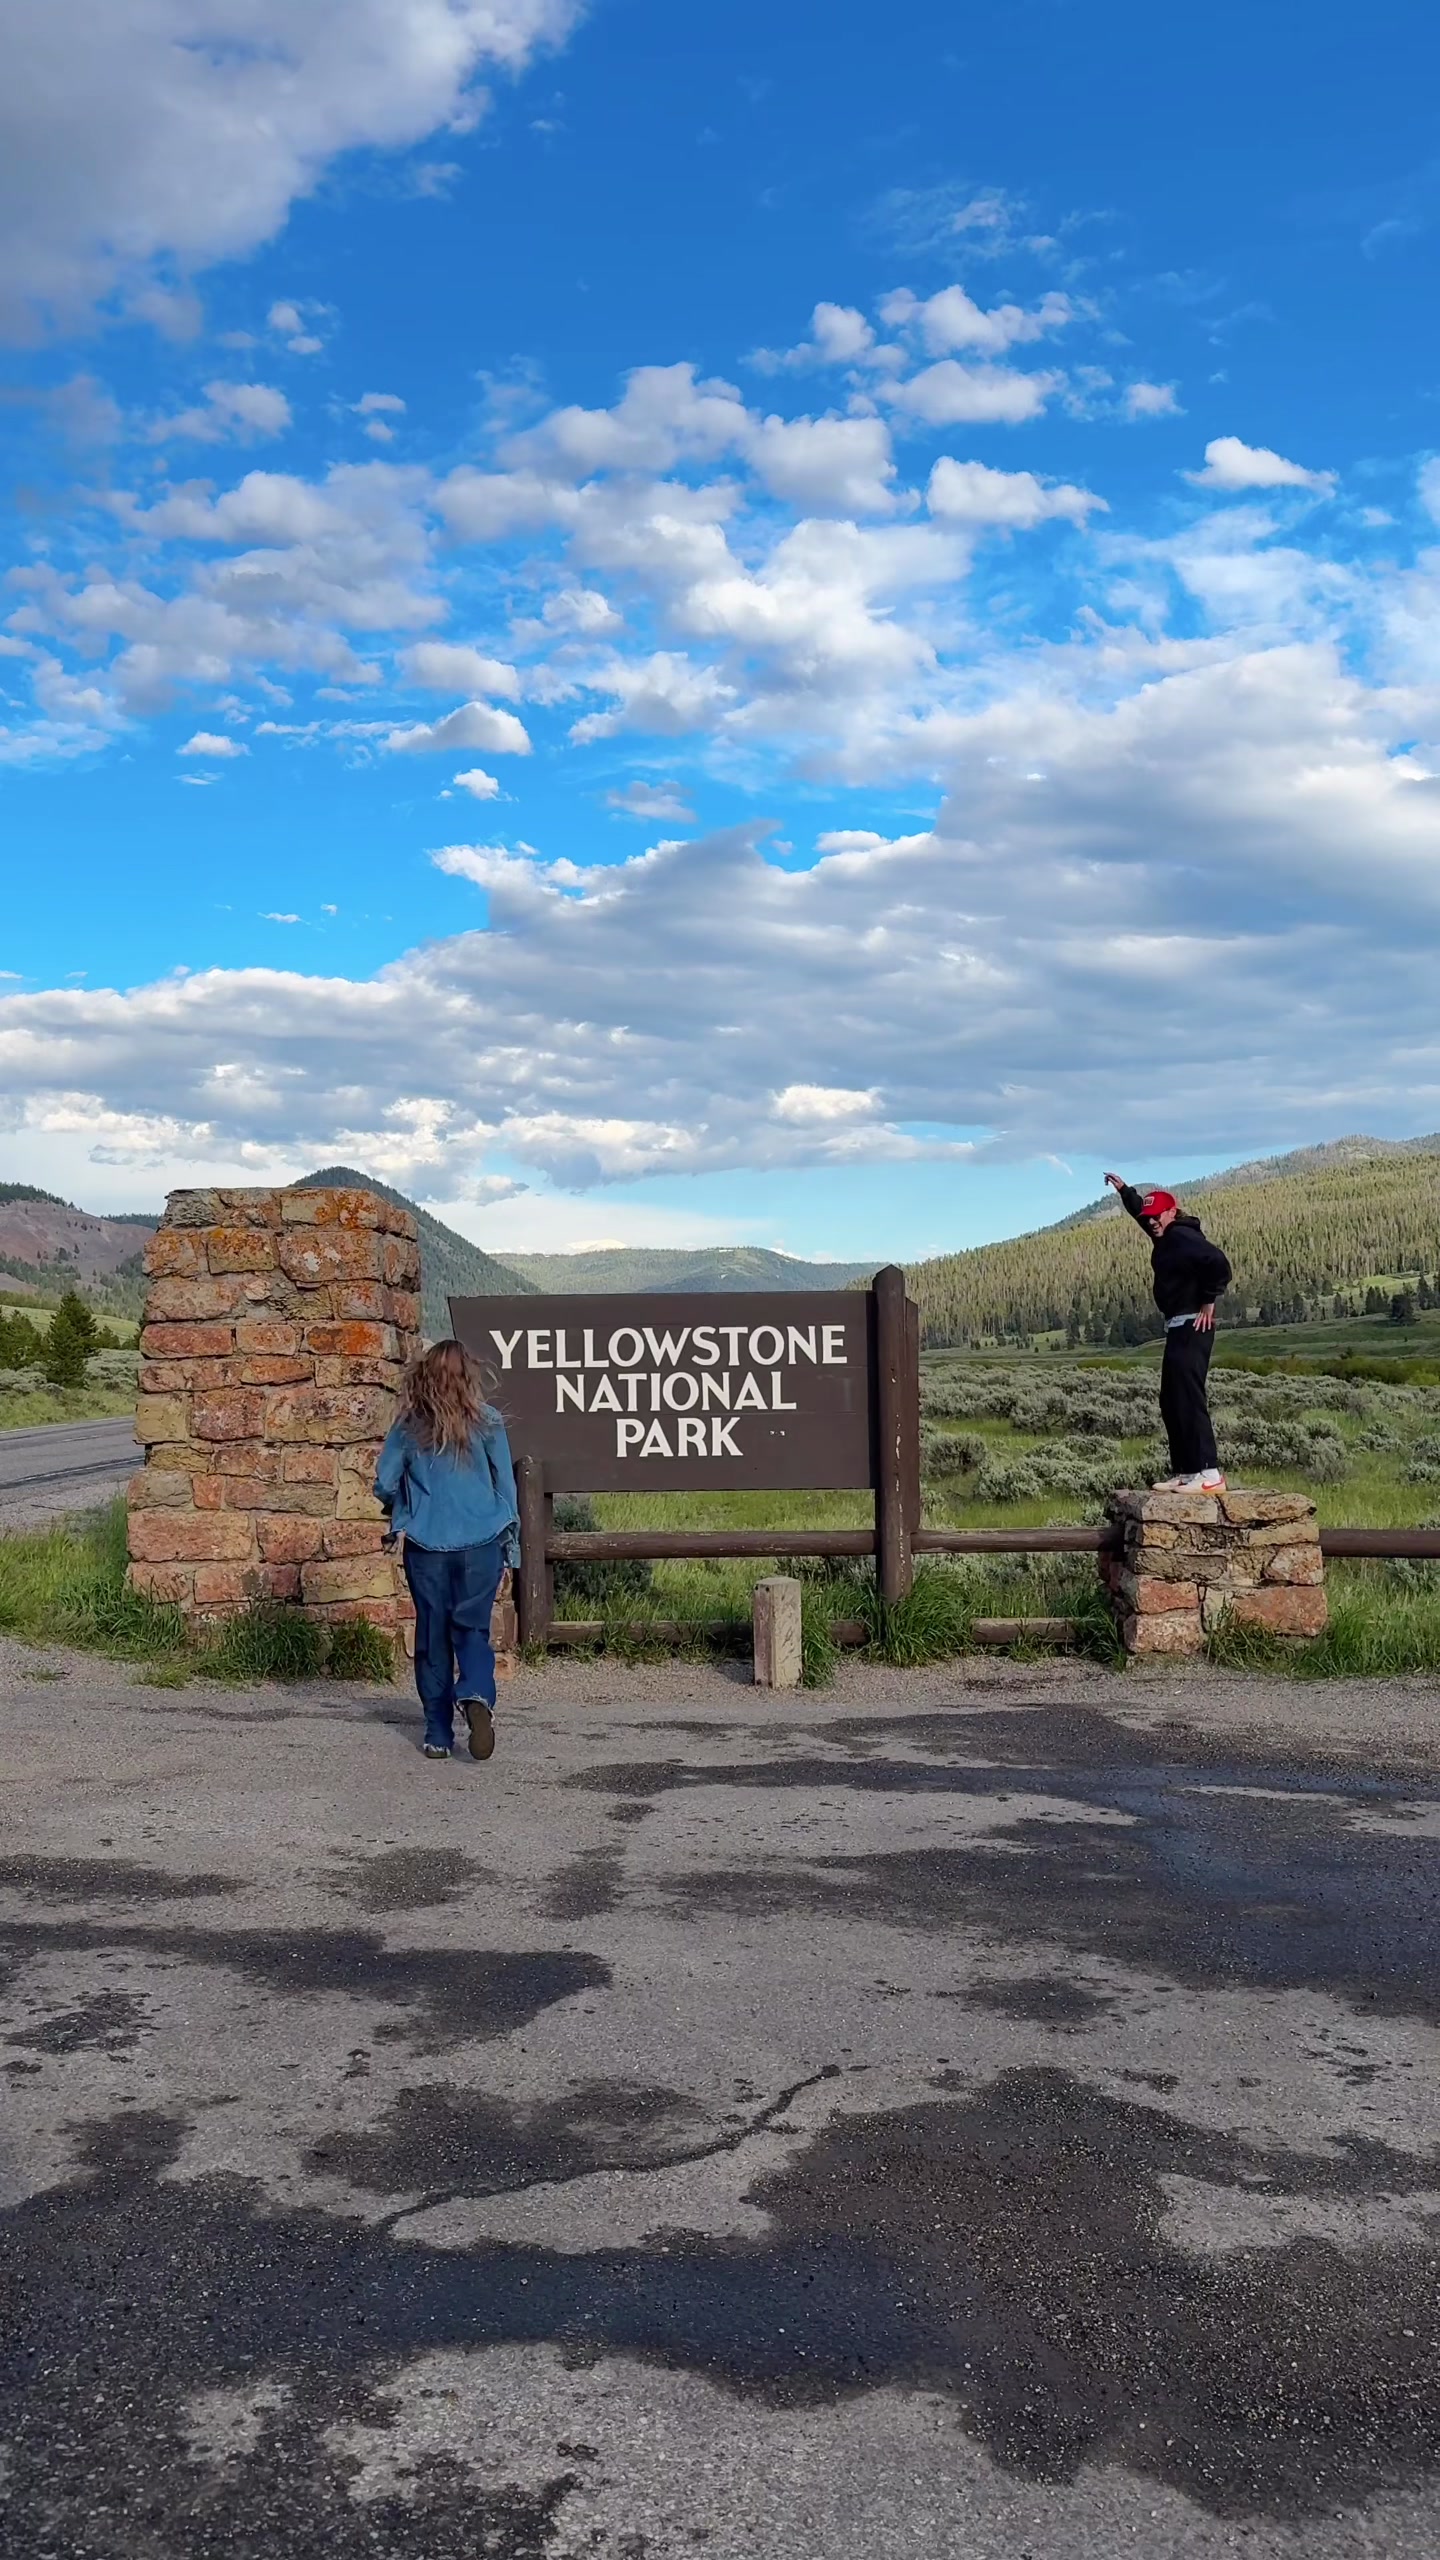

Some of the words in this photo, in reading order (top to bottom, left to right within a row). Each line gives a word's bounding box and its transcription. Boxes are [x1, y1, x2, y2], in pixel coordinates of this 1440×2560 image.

[488, 1324, 848, 1370] YELLOWSTONE
[555, 1371, 797, 1413] NATIONAL
[616, 1416, 744, 1458] PARK
